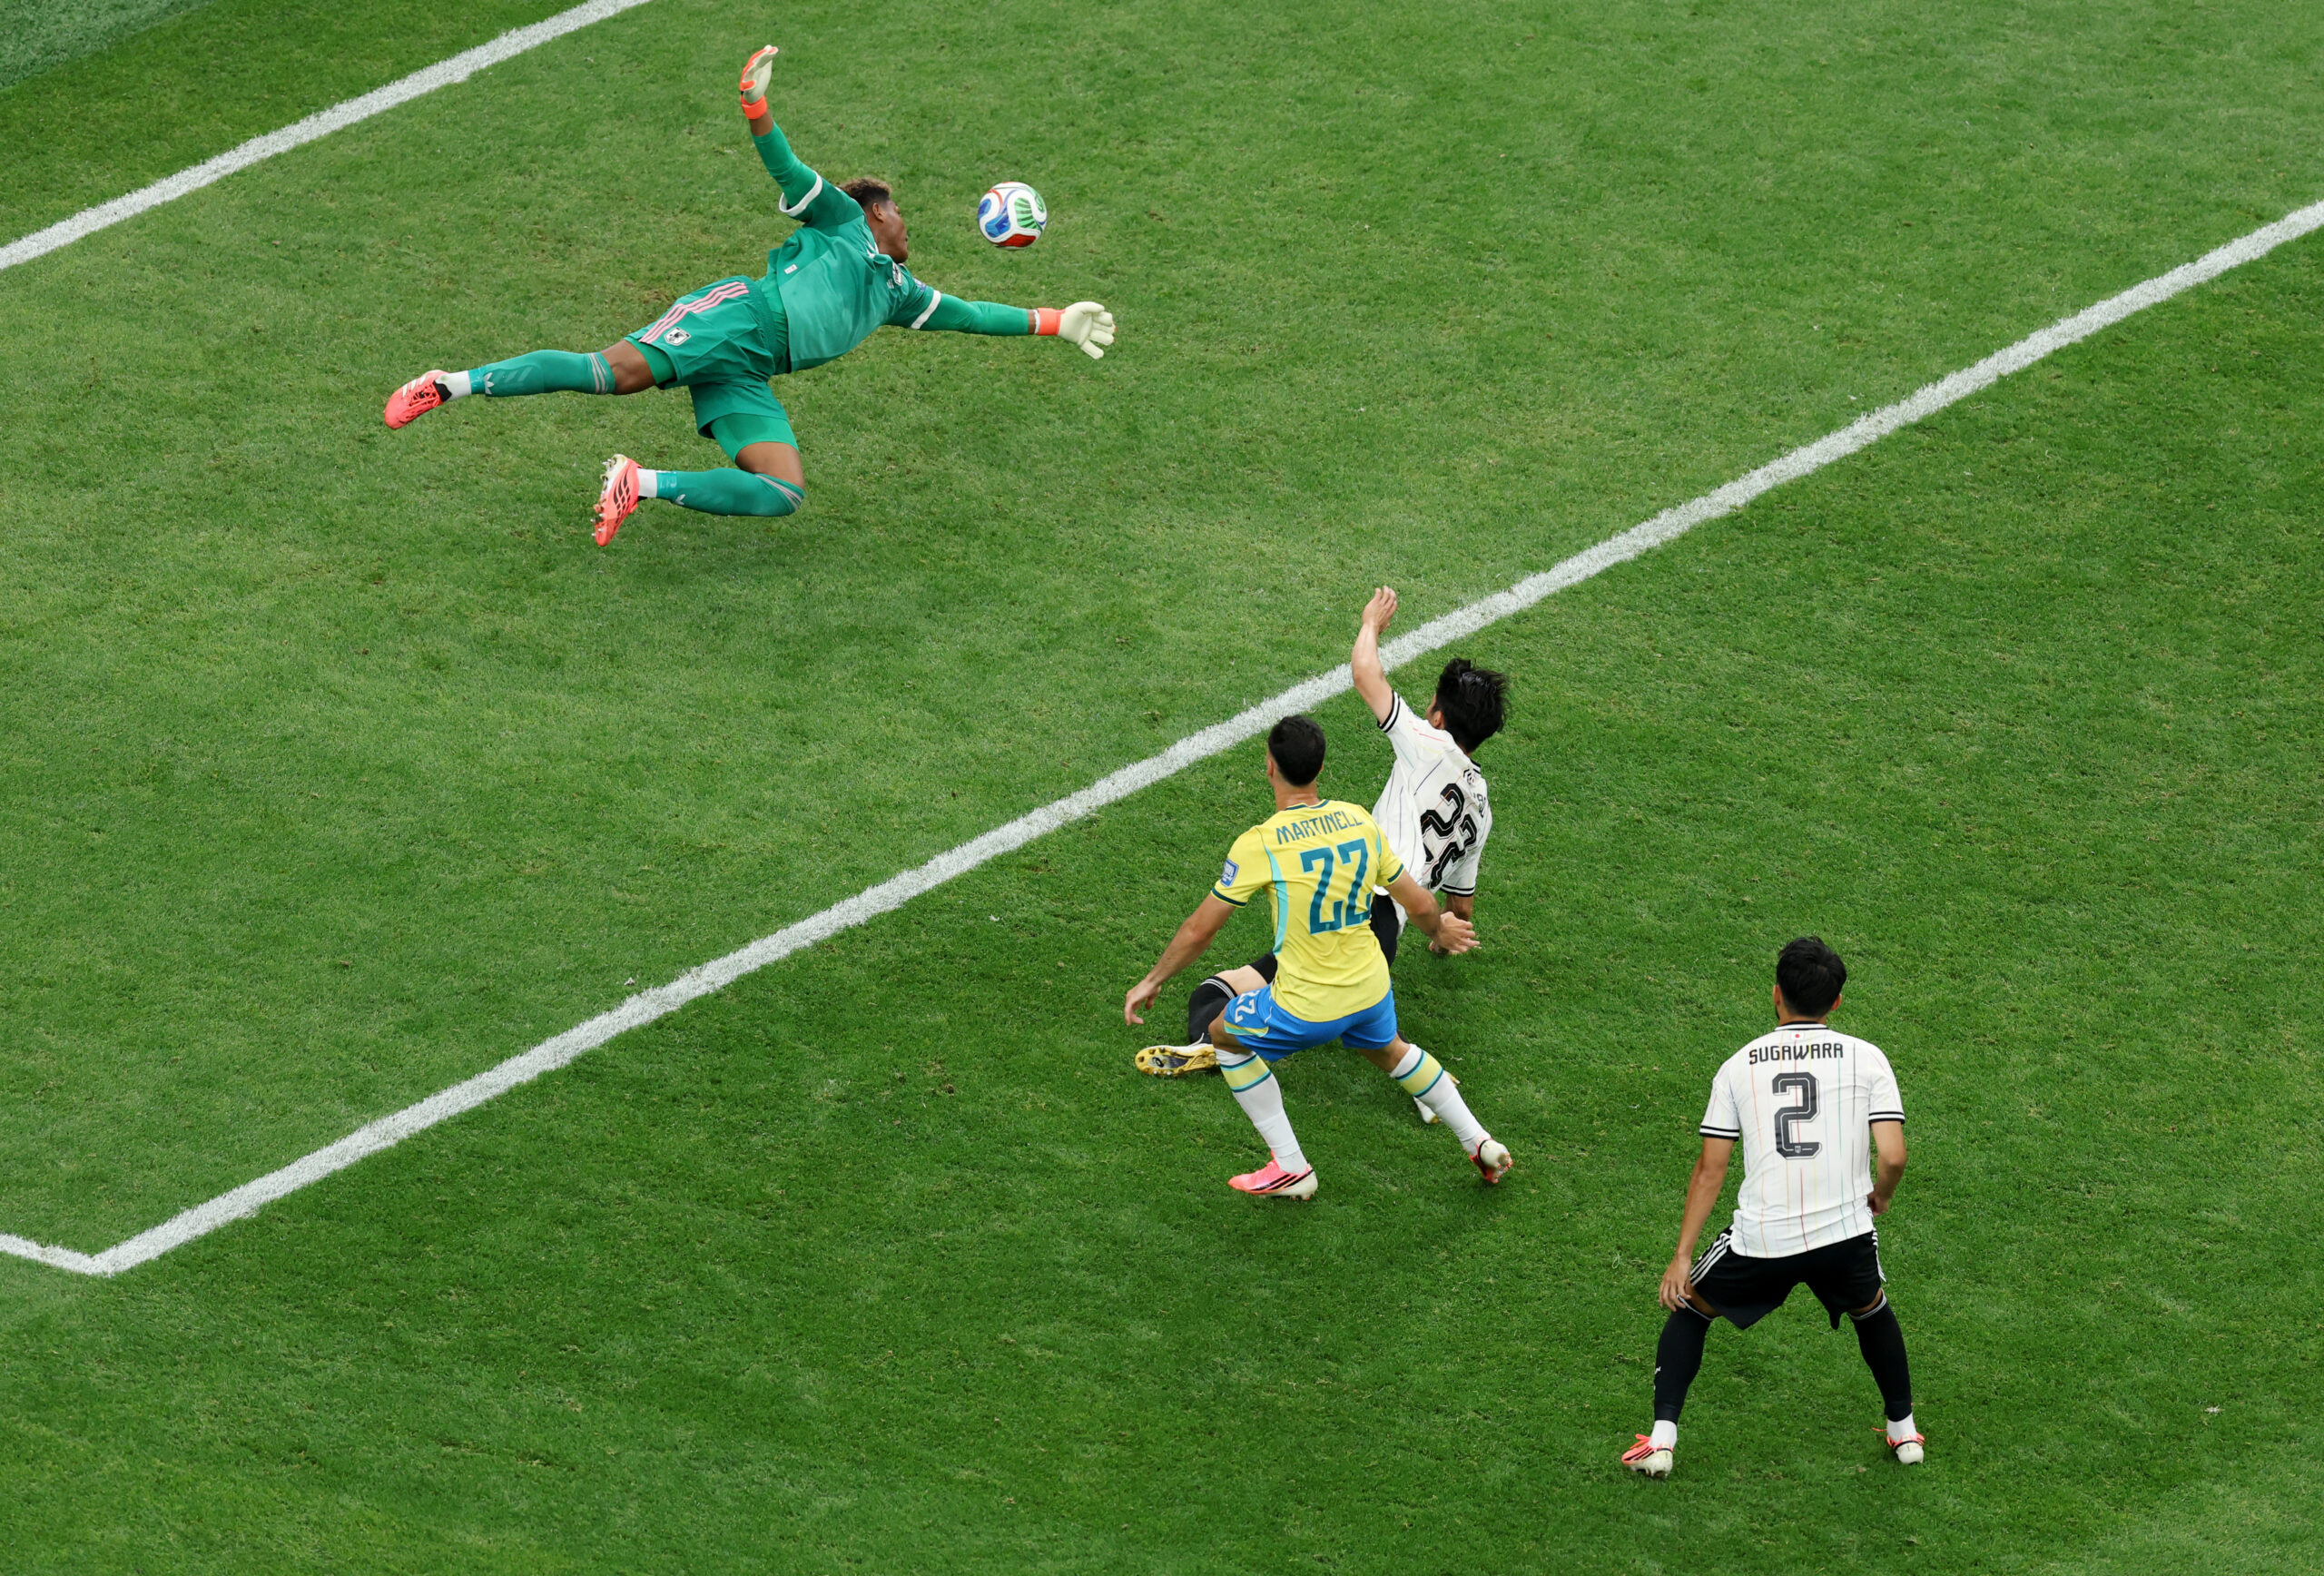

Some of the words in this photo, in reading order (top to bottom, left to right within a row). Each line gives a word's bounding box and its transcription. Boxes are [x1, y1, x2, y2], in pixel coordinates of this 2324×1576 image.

[1299, 838, 1372, 935] 22
[1748, 1043, 1844, 1065] SUGAWARA
[1772, 1072, 1822, 1160] 2
